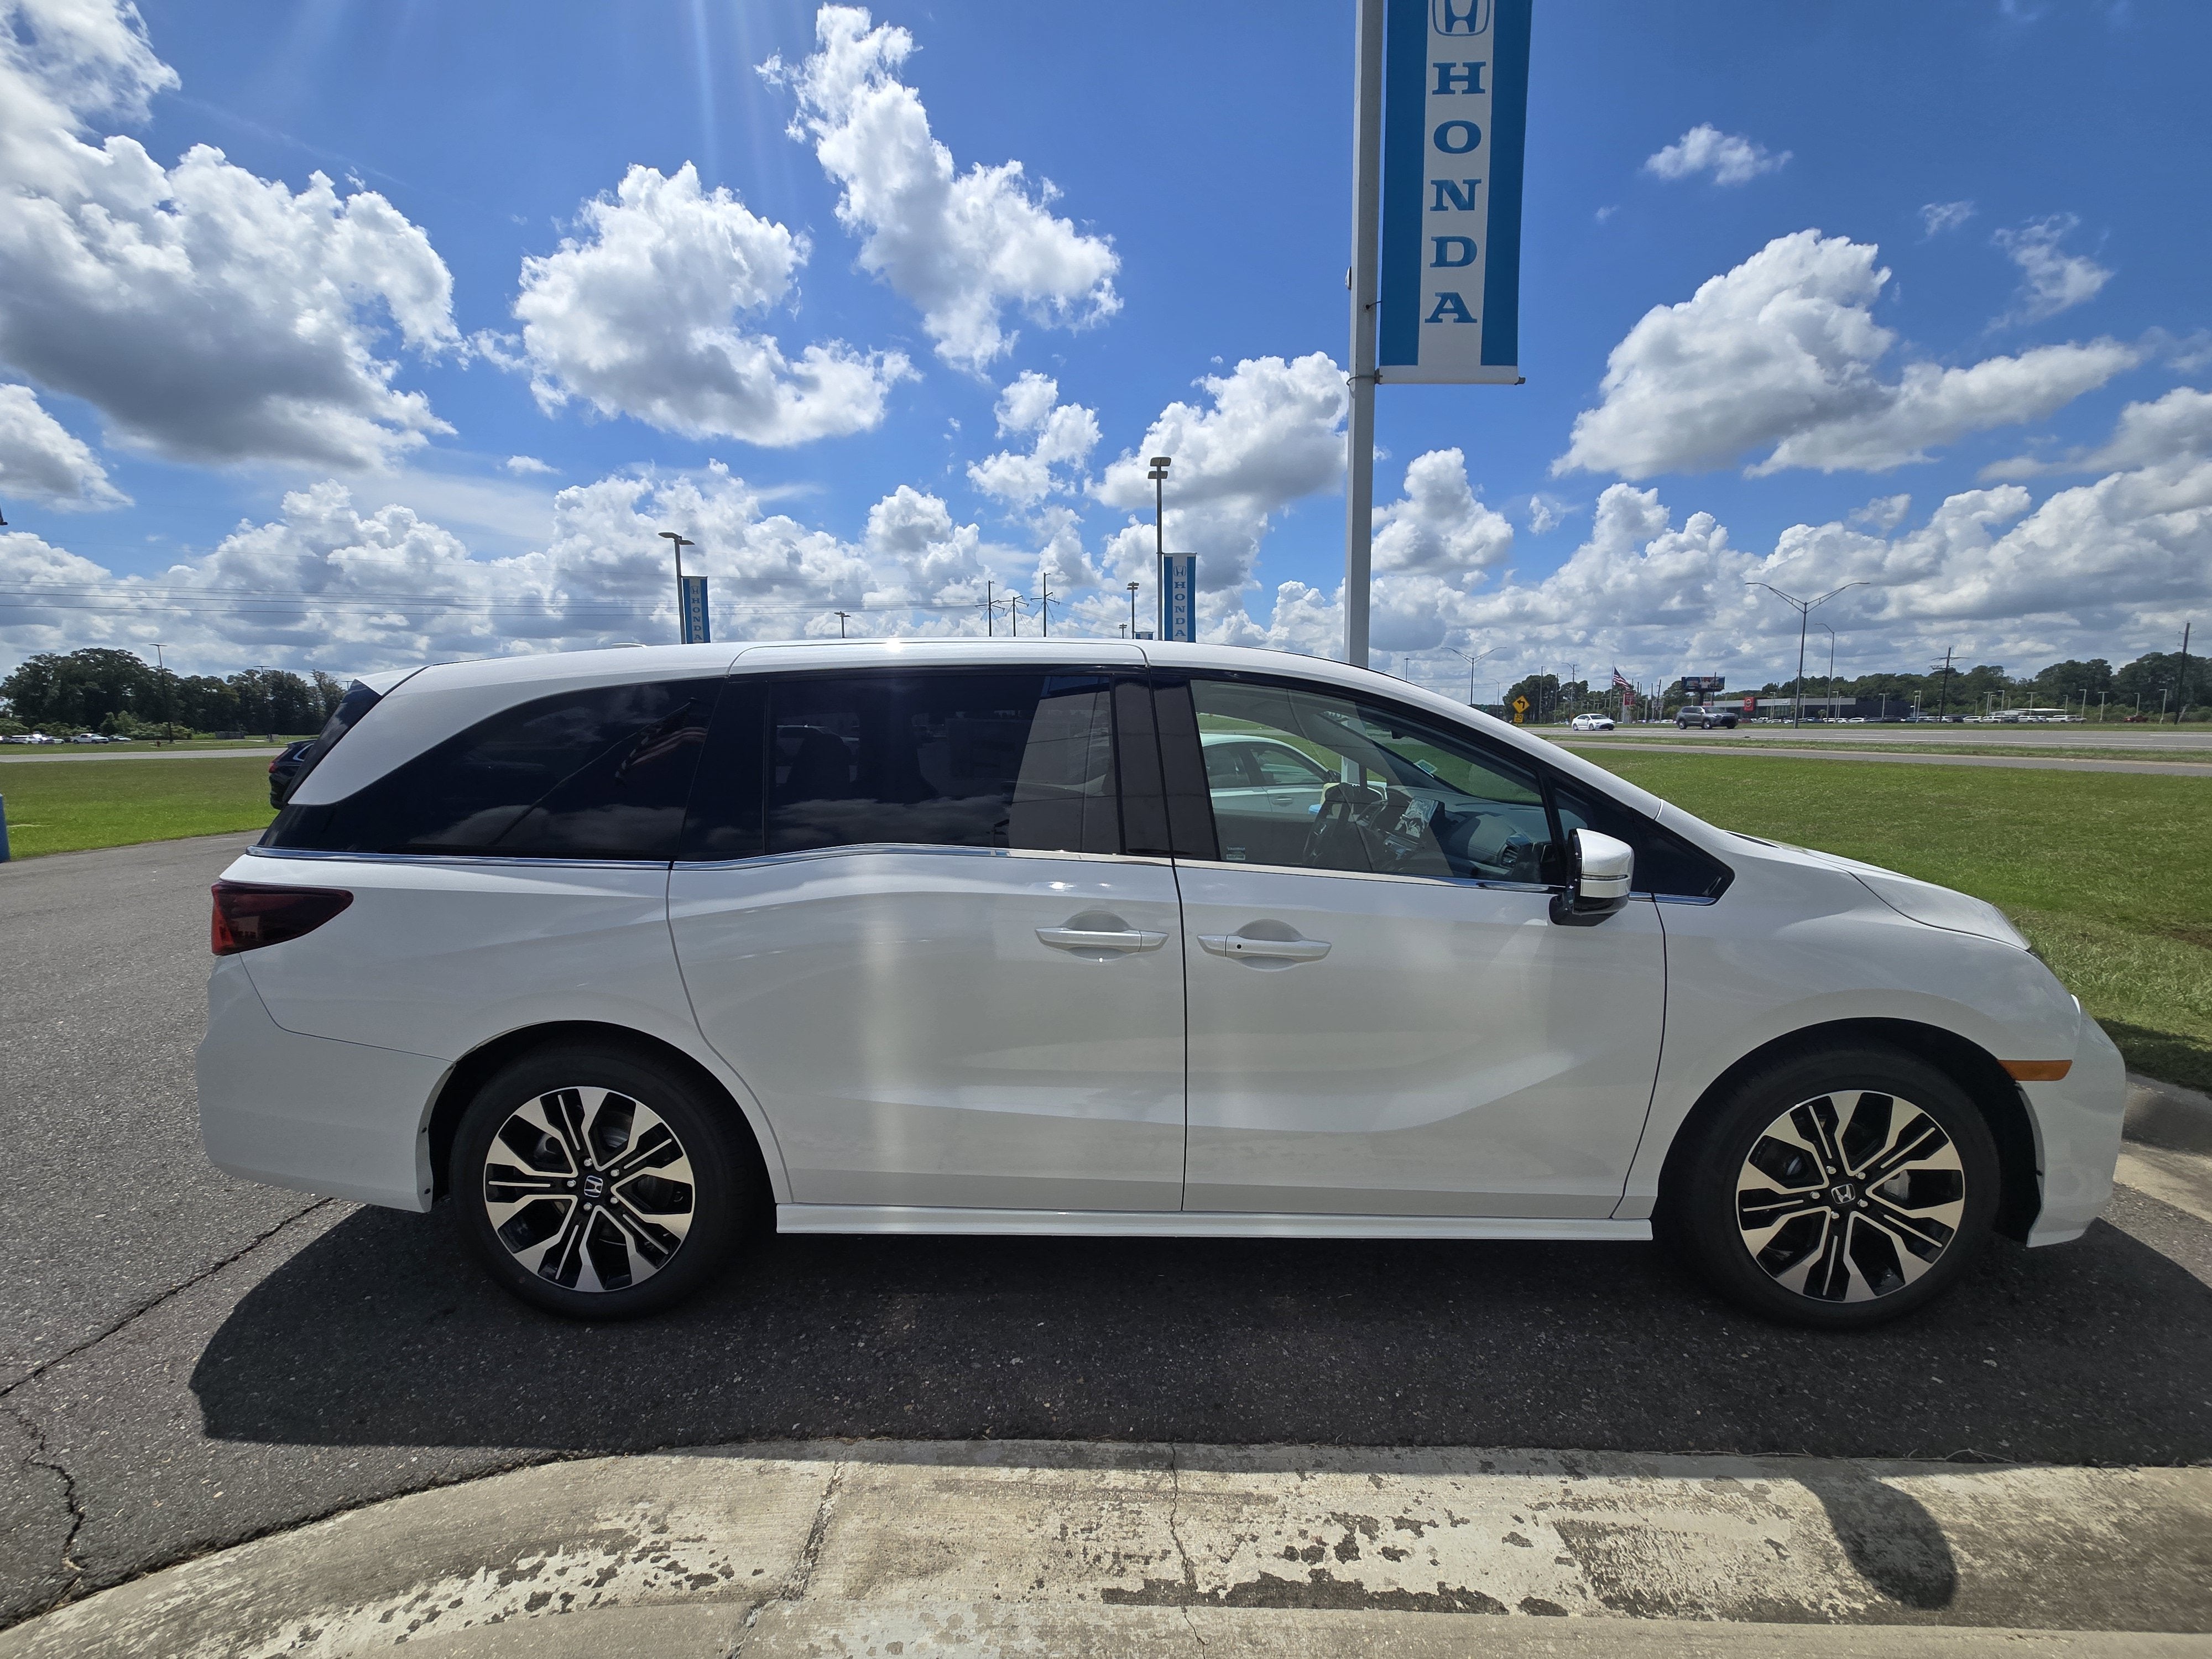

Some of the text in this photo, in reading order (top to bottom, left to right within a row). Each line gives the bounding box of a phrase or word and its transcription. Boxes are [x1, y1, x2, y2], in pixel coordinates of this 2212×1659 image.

[1425, 61, 1486, 324] HONDA
[691, 598, 703, 640] HONDA
[1174, 581, 1186, 637] HONDA
